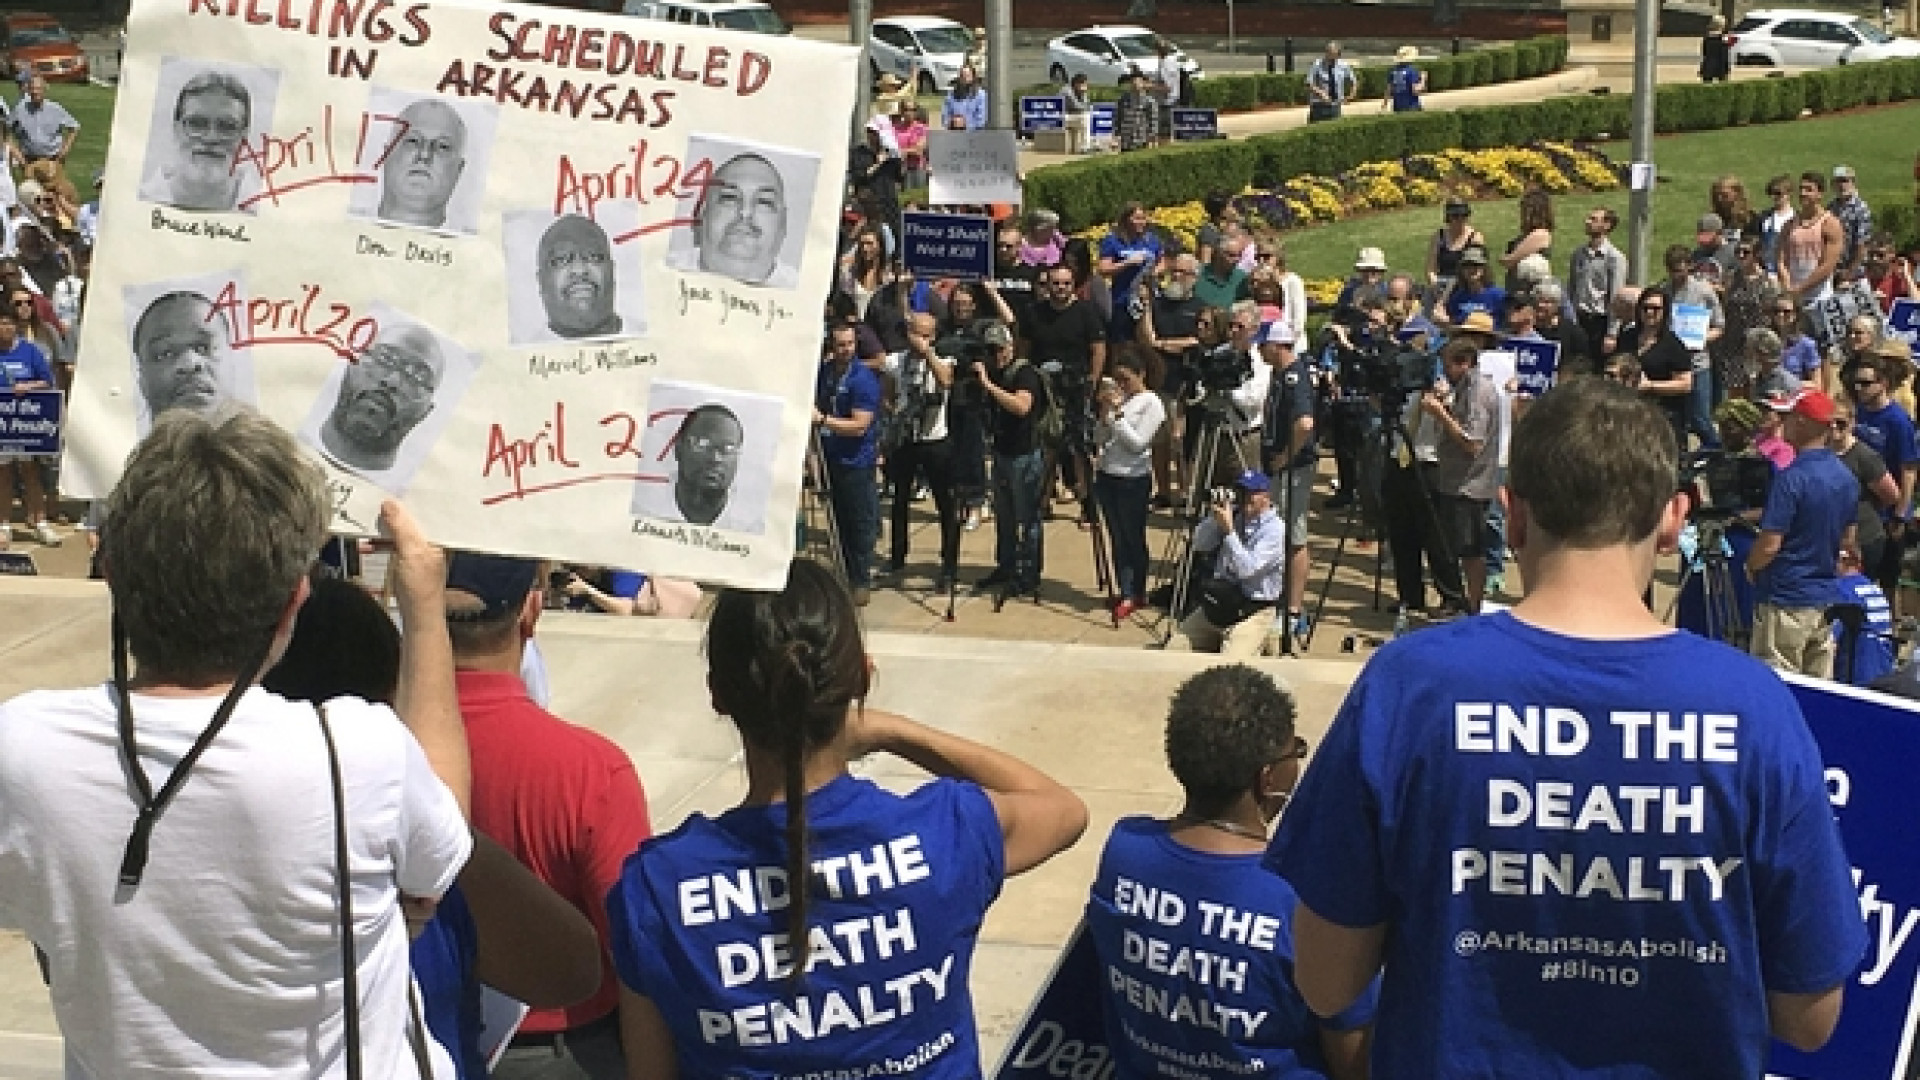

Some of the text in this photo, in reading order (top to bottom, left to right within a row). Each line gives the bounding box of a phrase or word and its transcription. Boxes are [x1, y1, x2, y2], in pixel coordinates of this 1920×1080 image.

[328, 46, 675, 128] IN ARKANSAS
[486, 12, 772, 96] SCHEDULED
[229, 104, 412, 207] April 17
[554, 138, 725, 222] April 24
[905, 221, 989, 242] Thou Shalt
[915, 242, 978, 260] Not Kill
[205, 281, 379, 355] April 20
[0, 398, 17, 416] nd
[482, 401, 697, 499] April 27
[1453, 700, 1739, 763] END THE
[1487, 778, 1705, 834] DEATH
[676, 831, 931, 927] END THE
[1451, 847, 1744, 902] PENALTY
[715, 907, 918, 989] DEATH
[1113, 874, 1280, 952] END THE
[1454, 929, 1728, 965] @ArkansasAbolish
[1122, 927, 1250, 995] DEATH
[697, 952, 955, 1047] PENALTY
[1107, 964, 1269, 1039] PENALTY
[1012, 1020, 1116, 1080] Dea
